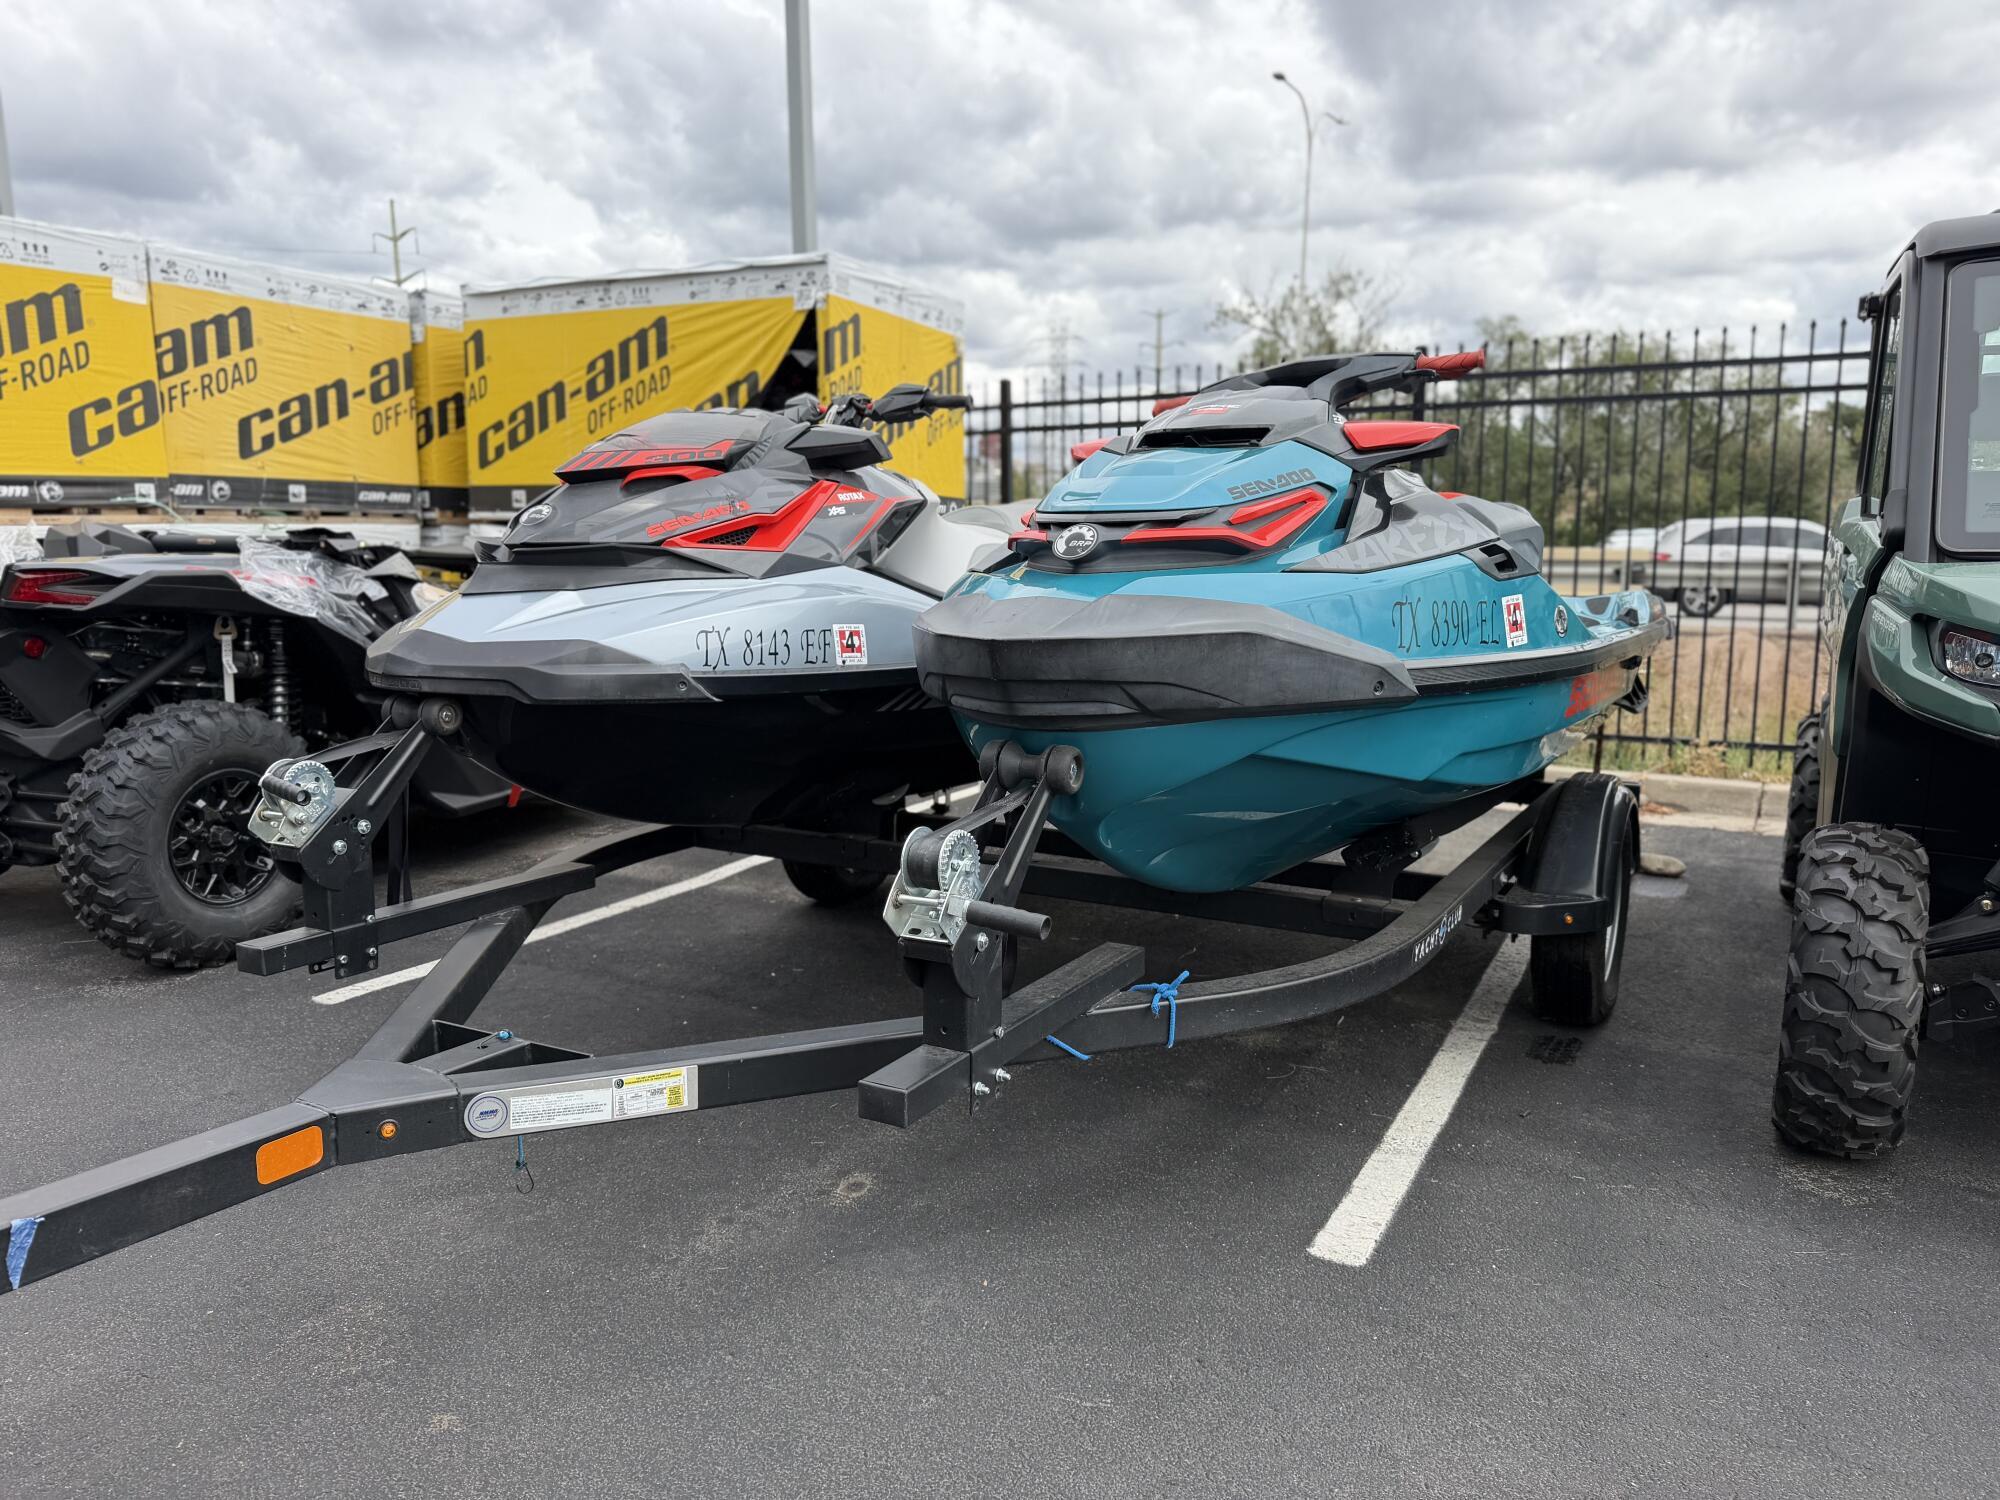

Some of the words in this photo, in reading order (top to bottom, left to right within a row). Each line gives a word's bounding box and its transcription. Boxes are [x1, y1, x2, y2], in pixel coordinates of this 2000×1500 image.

[478, 316, 668, 470] can-am
[588, 365, 671, 434] OFF-ROAD
[828, 506, 846, 516] XPS
[837, 492, 865, 502] ROTAX
[696, 626, 731, 670] TX
[743, 629, 791, 666] 8143
[846, 631, 856, 653] 4
[1392, 594, 1421, 653] TX
[1431, 600, 1469, 647] 8390
[1414, 928, 1440, 962] YACHT
[1447, 904, 1463, 933] CLUB
